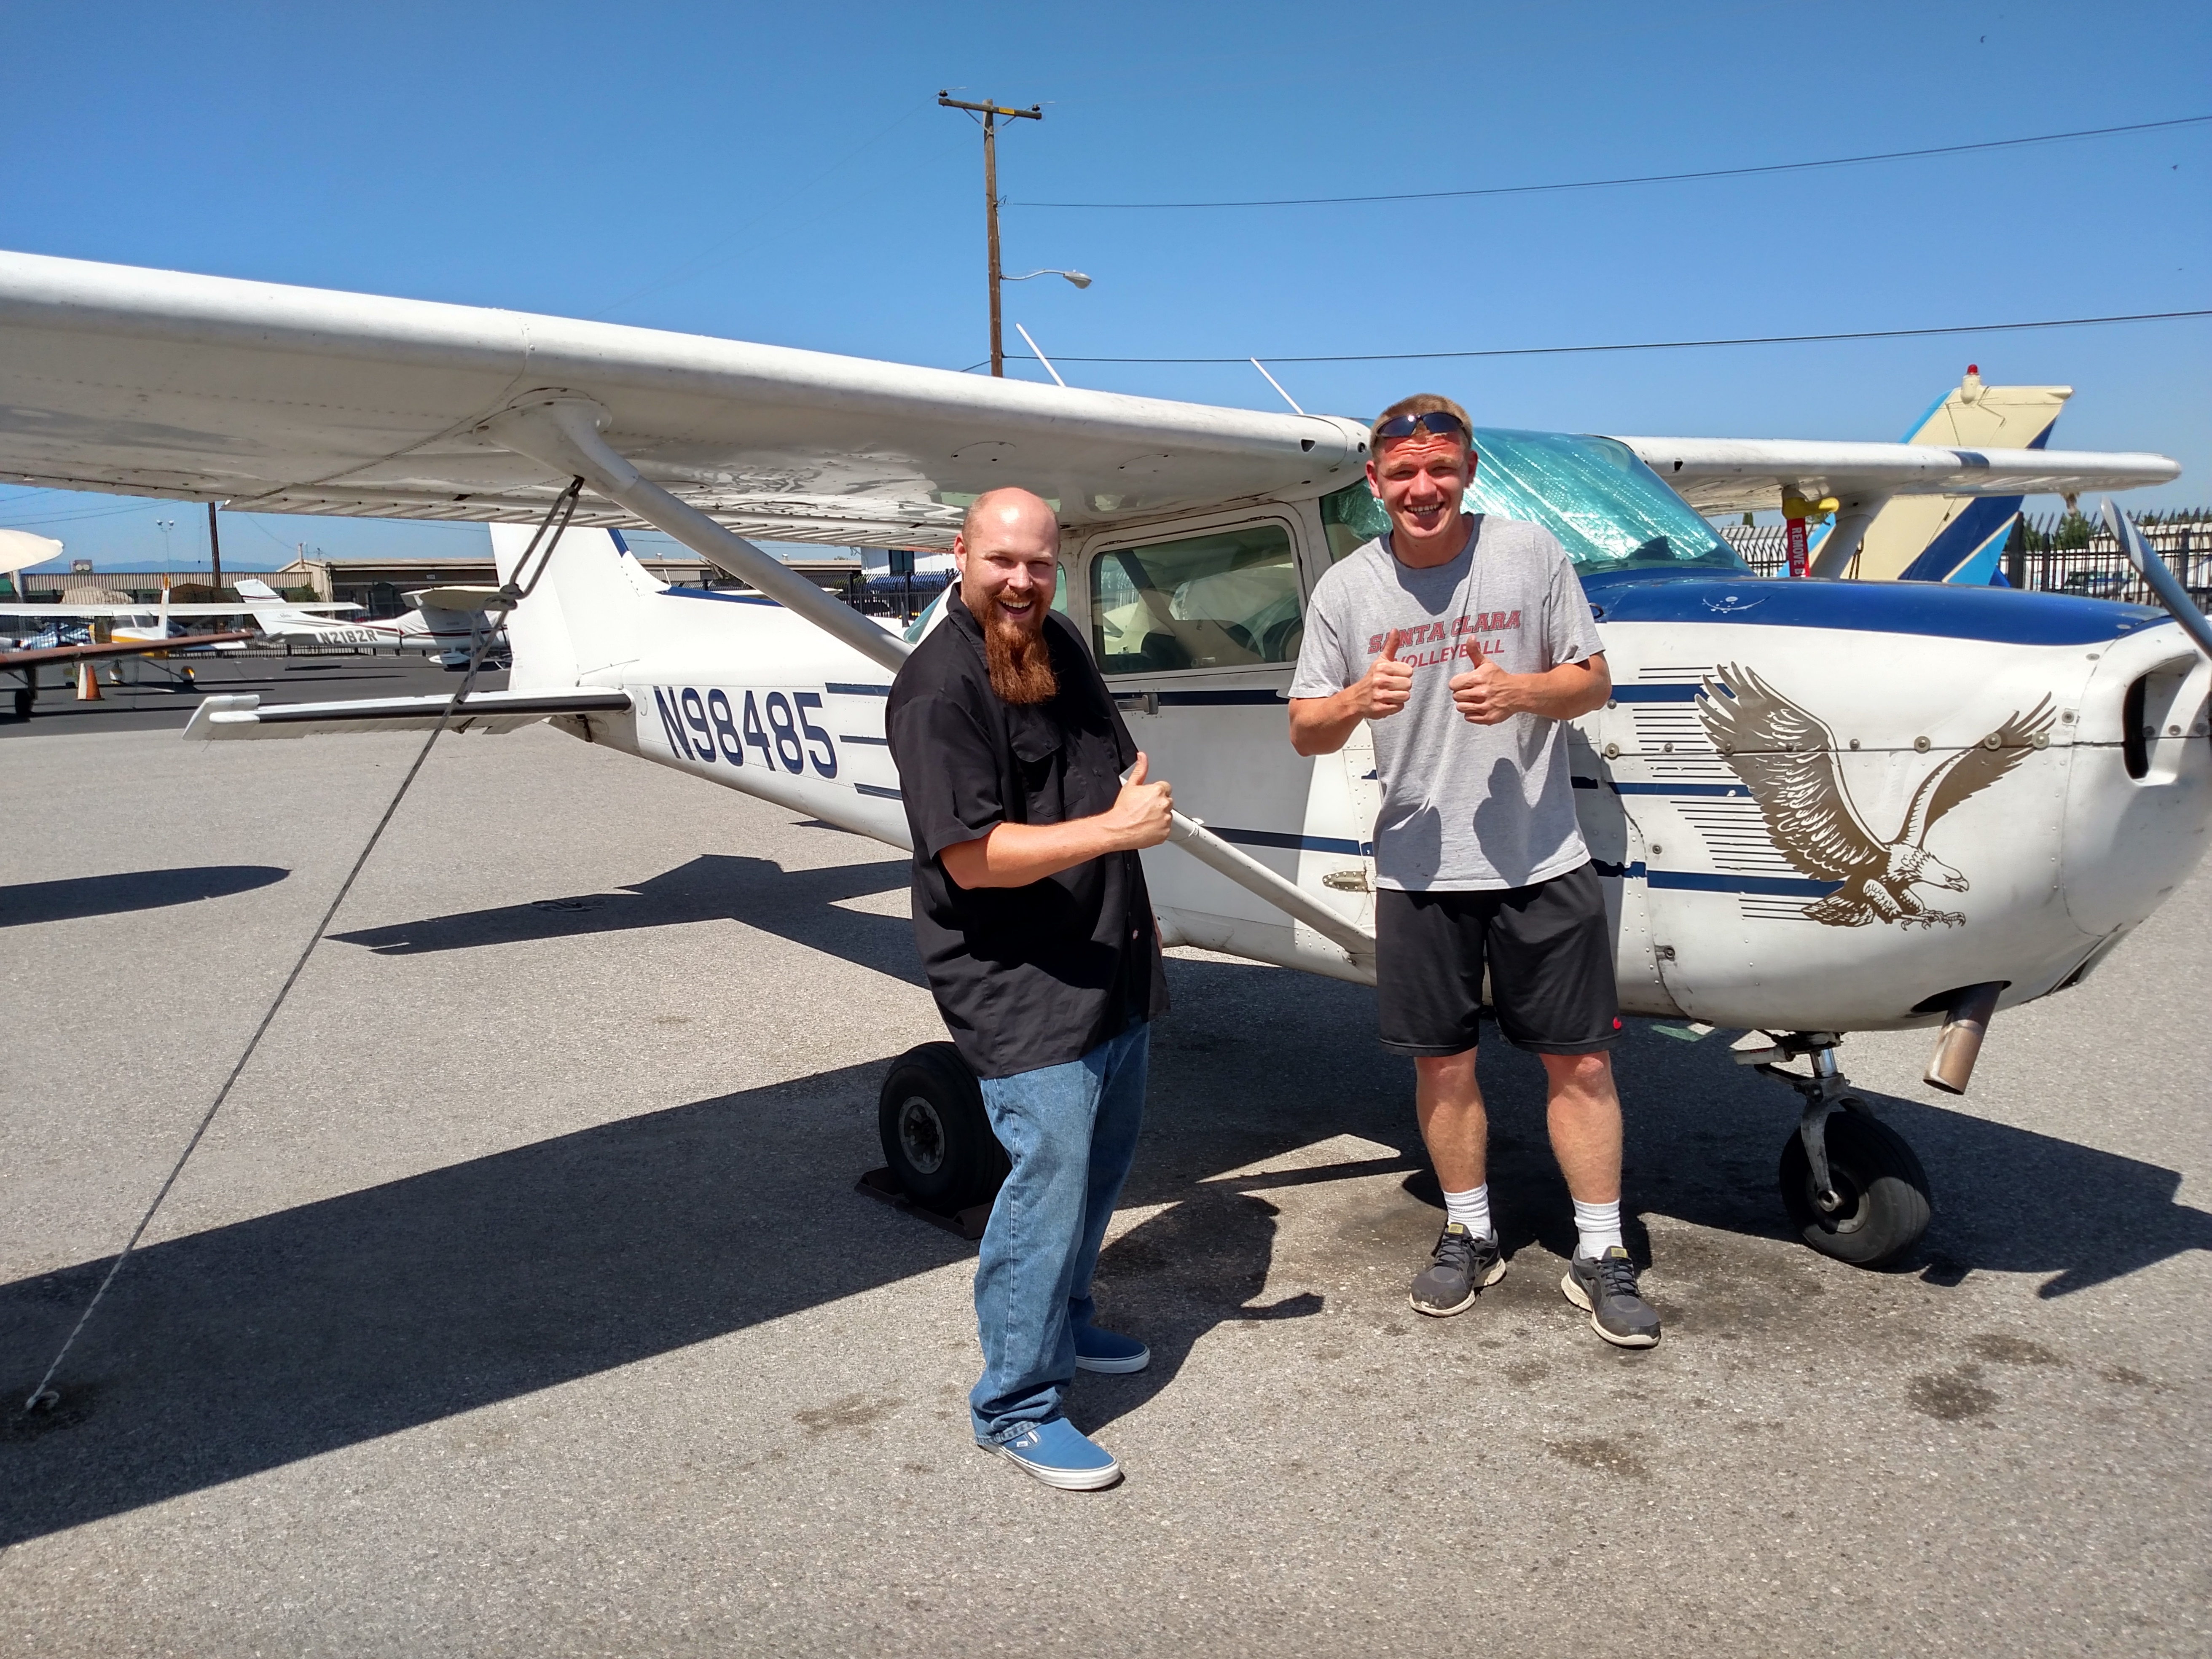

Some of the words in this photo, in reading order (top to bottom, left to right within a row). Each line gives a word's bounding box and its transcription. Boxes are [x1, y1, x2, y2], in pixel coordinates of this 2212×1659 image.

[1792, 527, 1804, 566] REMOVE
[319, 629, 378, 644] N2182R
[1451, 610, 1521, 637] CLARA
[653, 685, 838, 779] N98485
